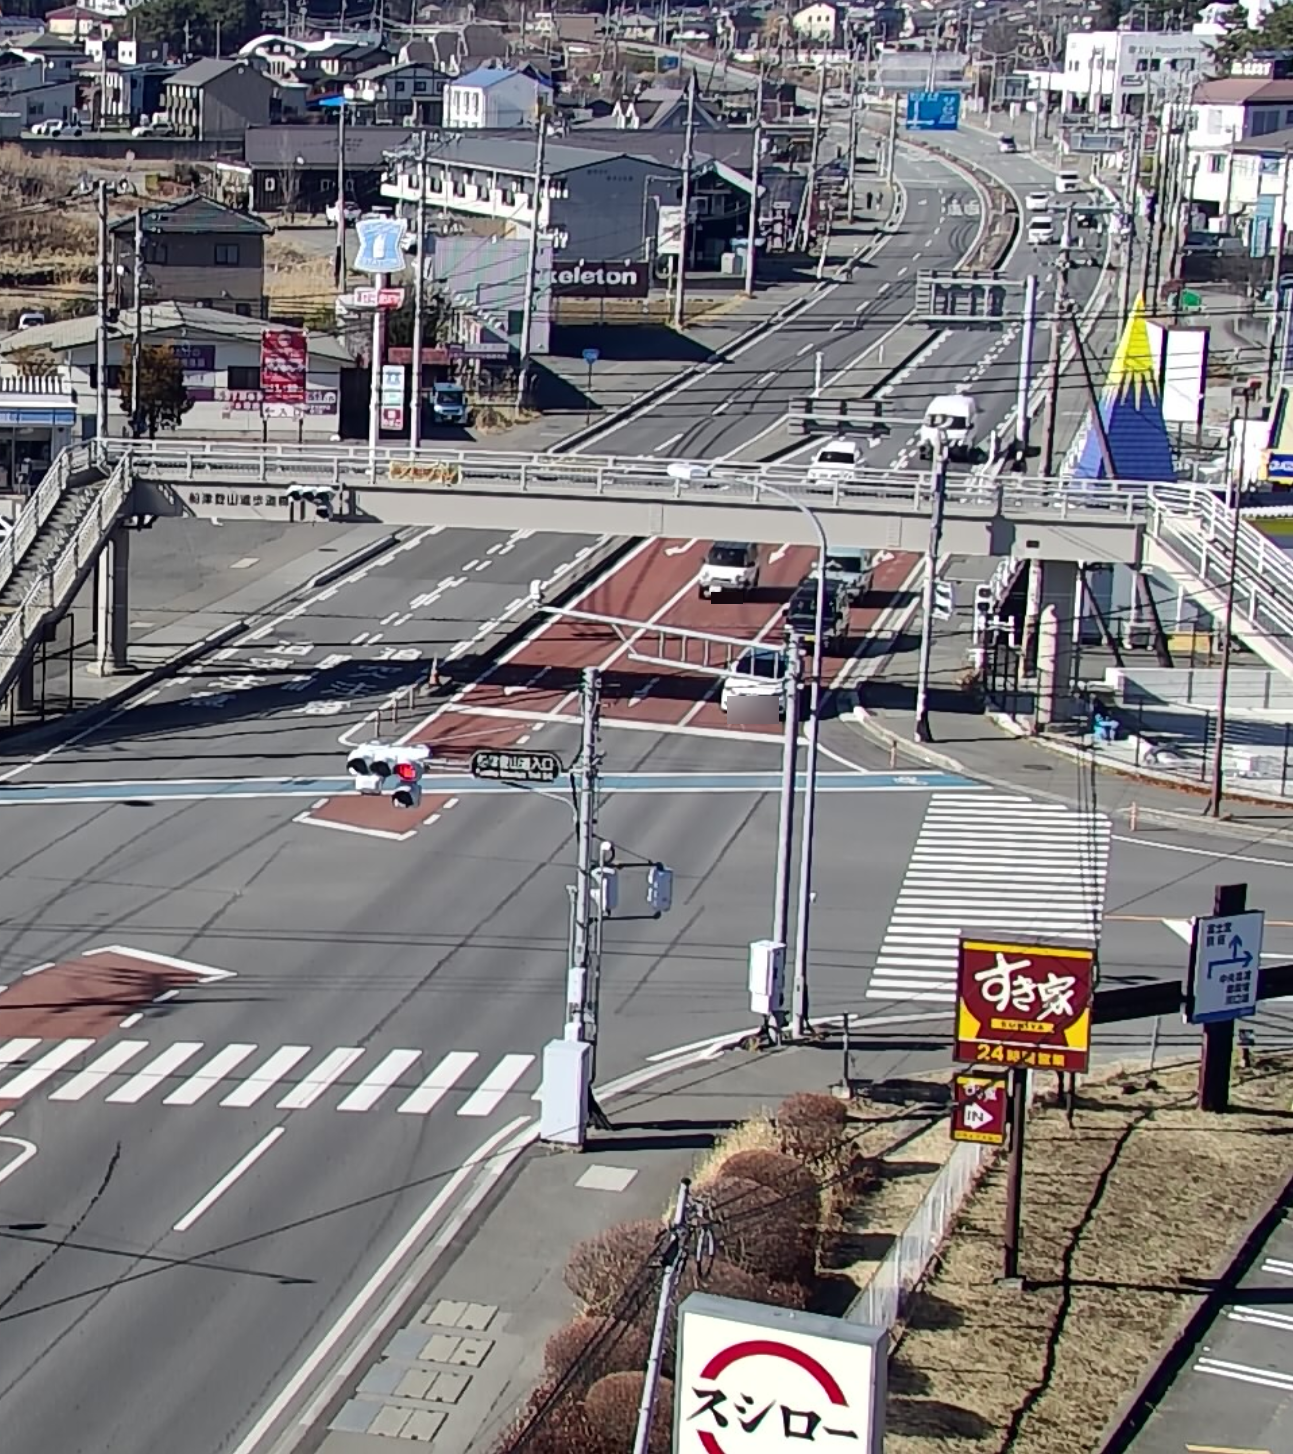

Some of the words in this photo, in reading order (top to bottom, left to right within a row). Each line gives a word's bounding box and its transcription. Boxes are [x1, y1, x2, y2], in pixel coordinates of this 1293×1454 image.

[974, 952, 1076, 1020] すき家
[967, 1110, 984, 1122] IN
[686, 1387, 859, 1442] スシロー
